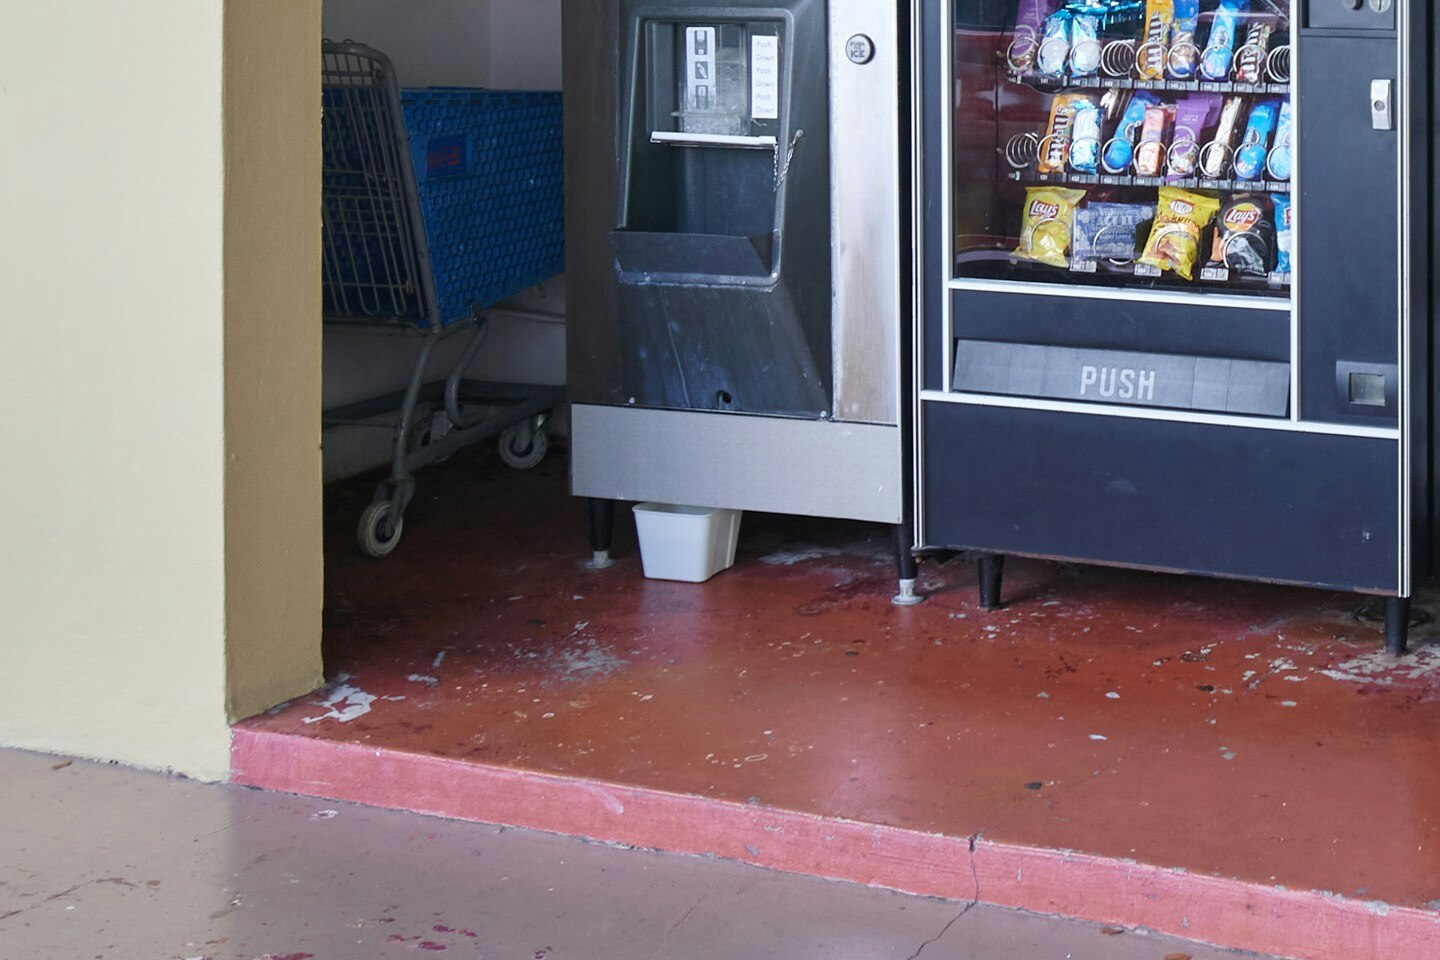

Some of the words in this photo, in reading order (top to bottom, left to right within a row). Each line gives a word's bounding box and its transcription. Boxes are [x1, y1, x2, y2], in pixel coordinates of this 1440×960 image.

[850, 50, 865, 58] ICE
[1030, 200, 1059, 219] Lay's
[1225, 208, 1259, 225] Lay's
[1080, 365, 1156, 401] PUSH
